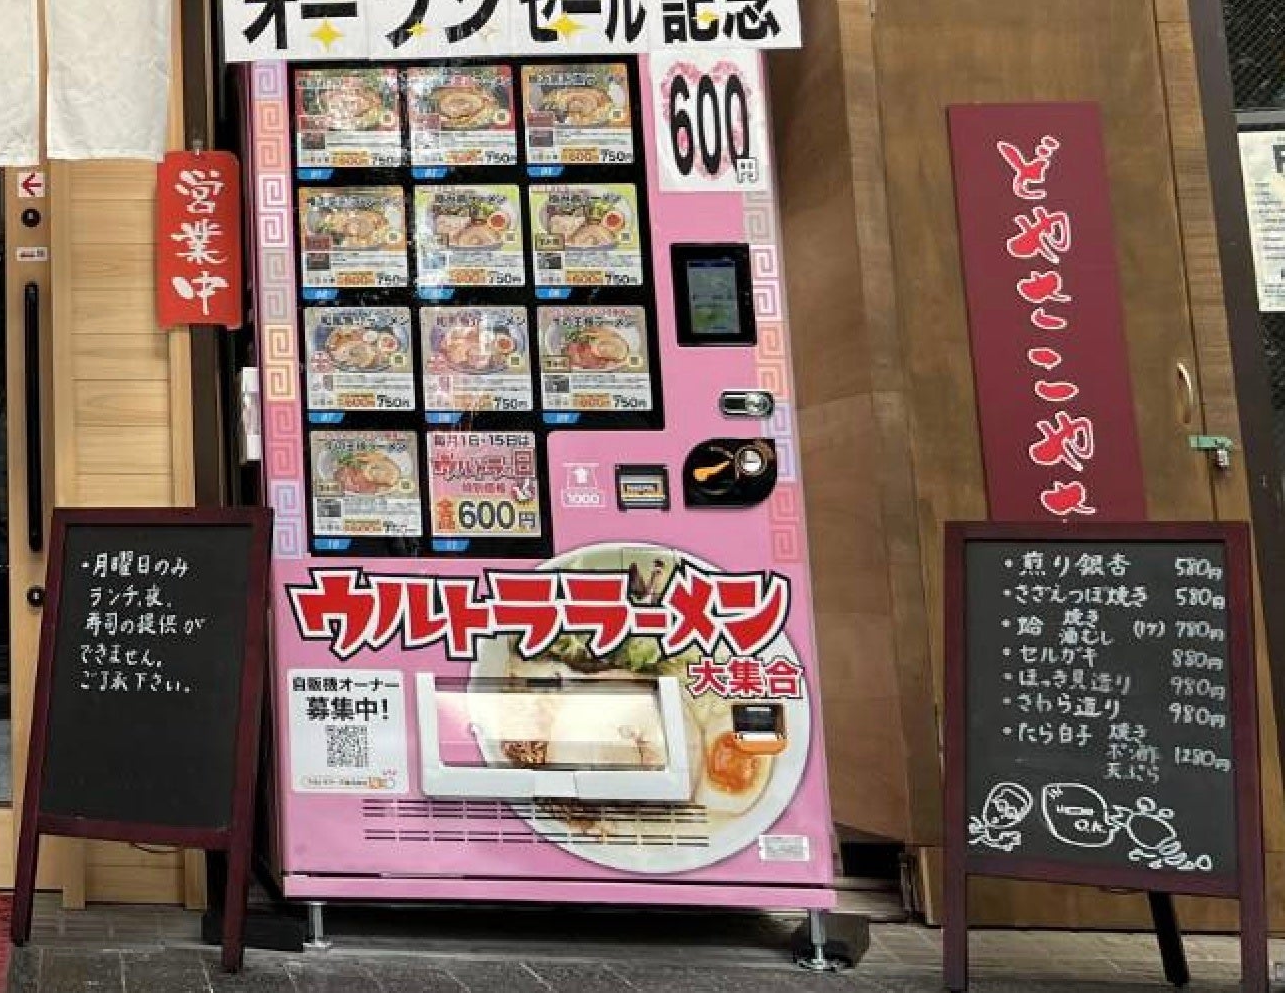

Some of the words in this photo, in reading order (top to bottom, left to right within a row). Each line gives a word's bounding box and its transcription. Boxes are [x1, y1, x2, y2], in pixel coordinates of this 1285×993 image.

[668, 73, 758, 184] 600円
[171, 169, 230, 316] 営業中
[458, 500, 537, 531] 600円
[92, 550, 189, 578] 月曜日のみ
[1019, 551, 1131, 577] 煎り銀杏
[1174, 557, 1224, 581] 580円
[285, 560, 791, 661] ウルトララーメン
[1174, 587, 1226, 609] 580円
[84, 612, 206, 636] 寿司の提供が
[1174, 620, 1225, 642] 780円
[1171, 649, 1224, 670] 880円
[292, 676, 400, 693] 自販機オーナー
[687, 656, 805, 699] 大集合
[1170, 676, 1226, 699] 980円
[305, 696, 390, 721] 募集中!
[1168, 702, 1226, 728] 980円
